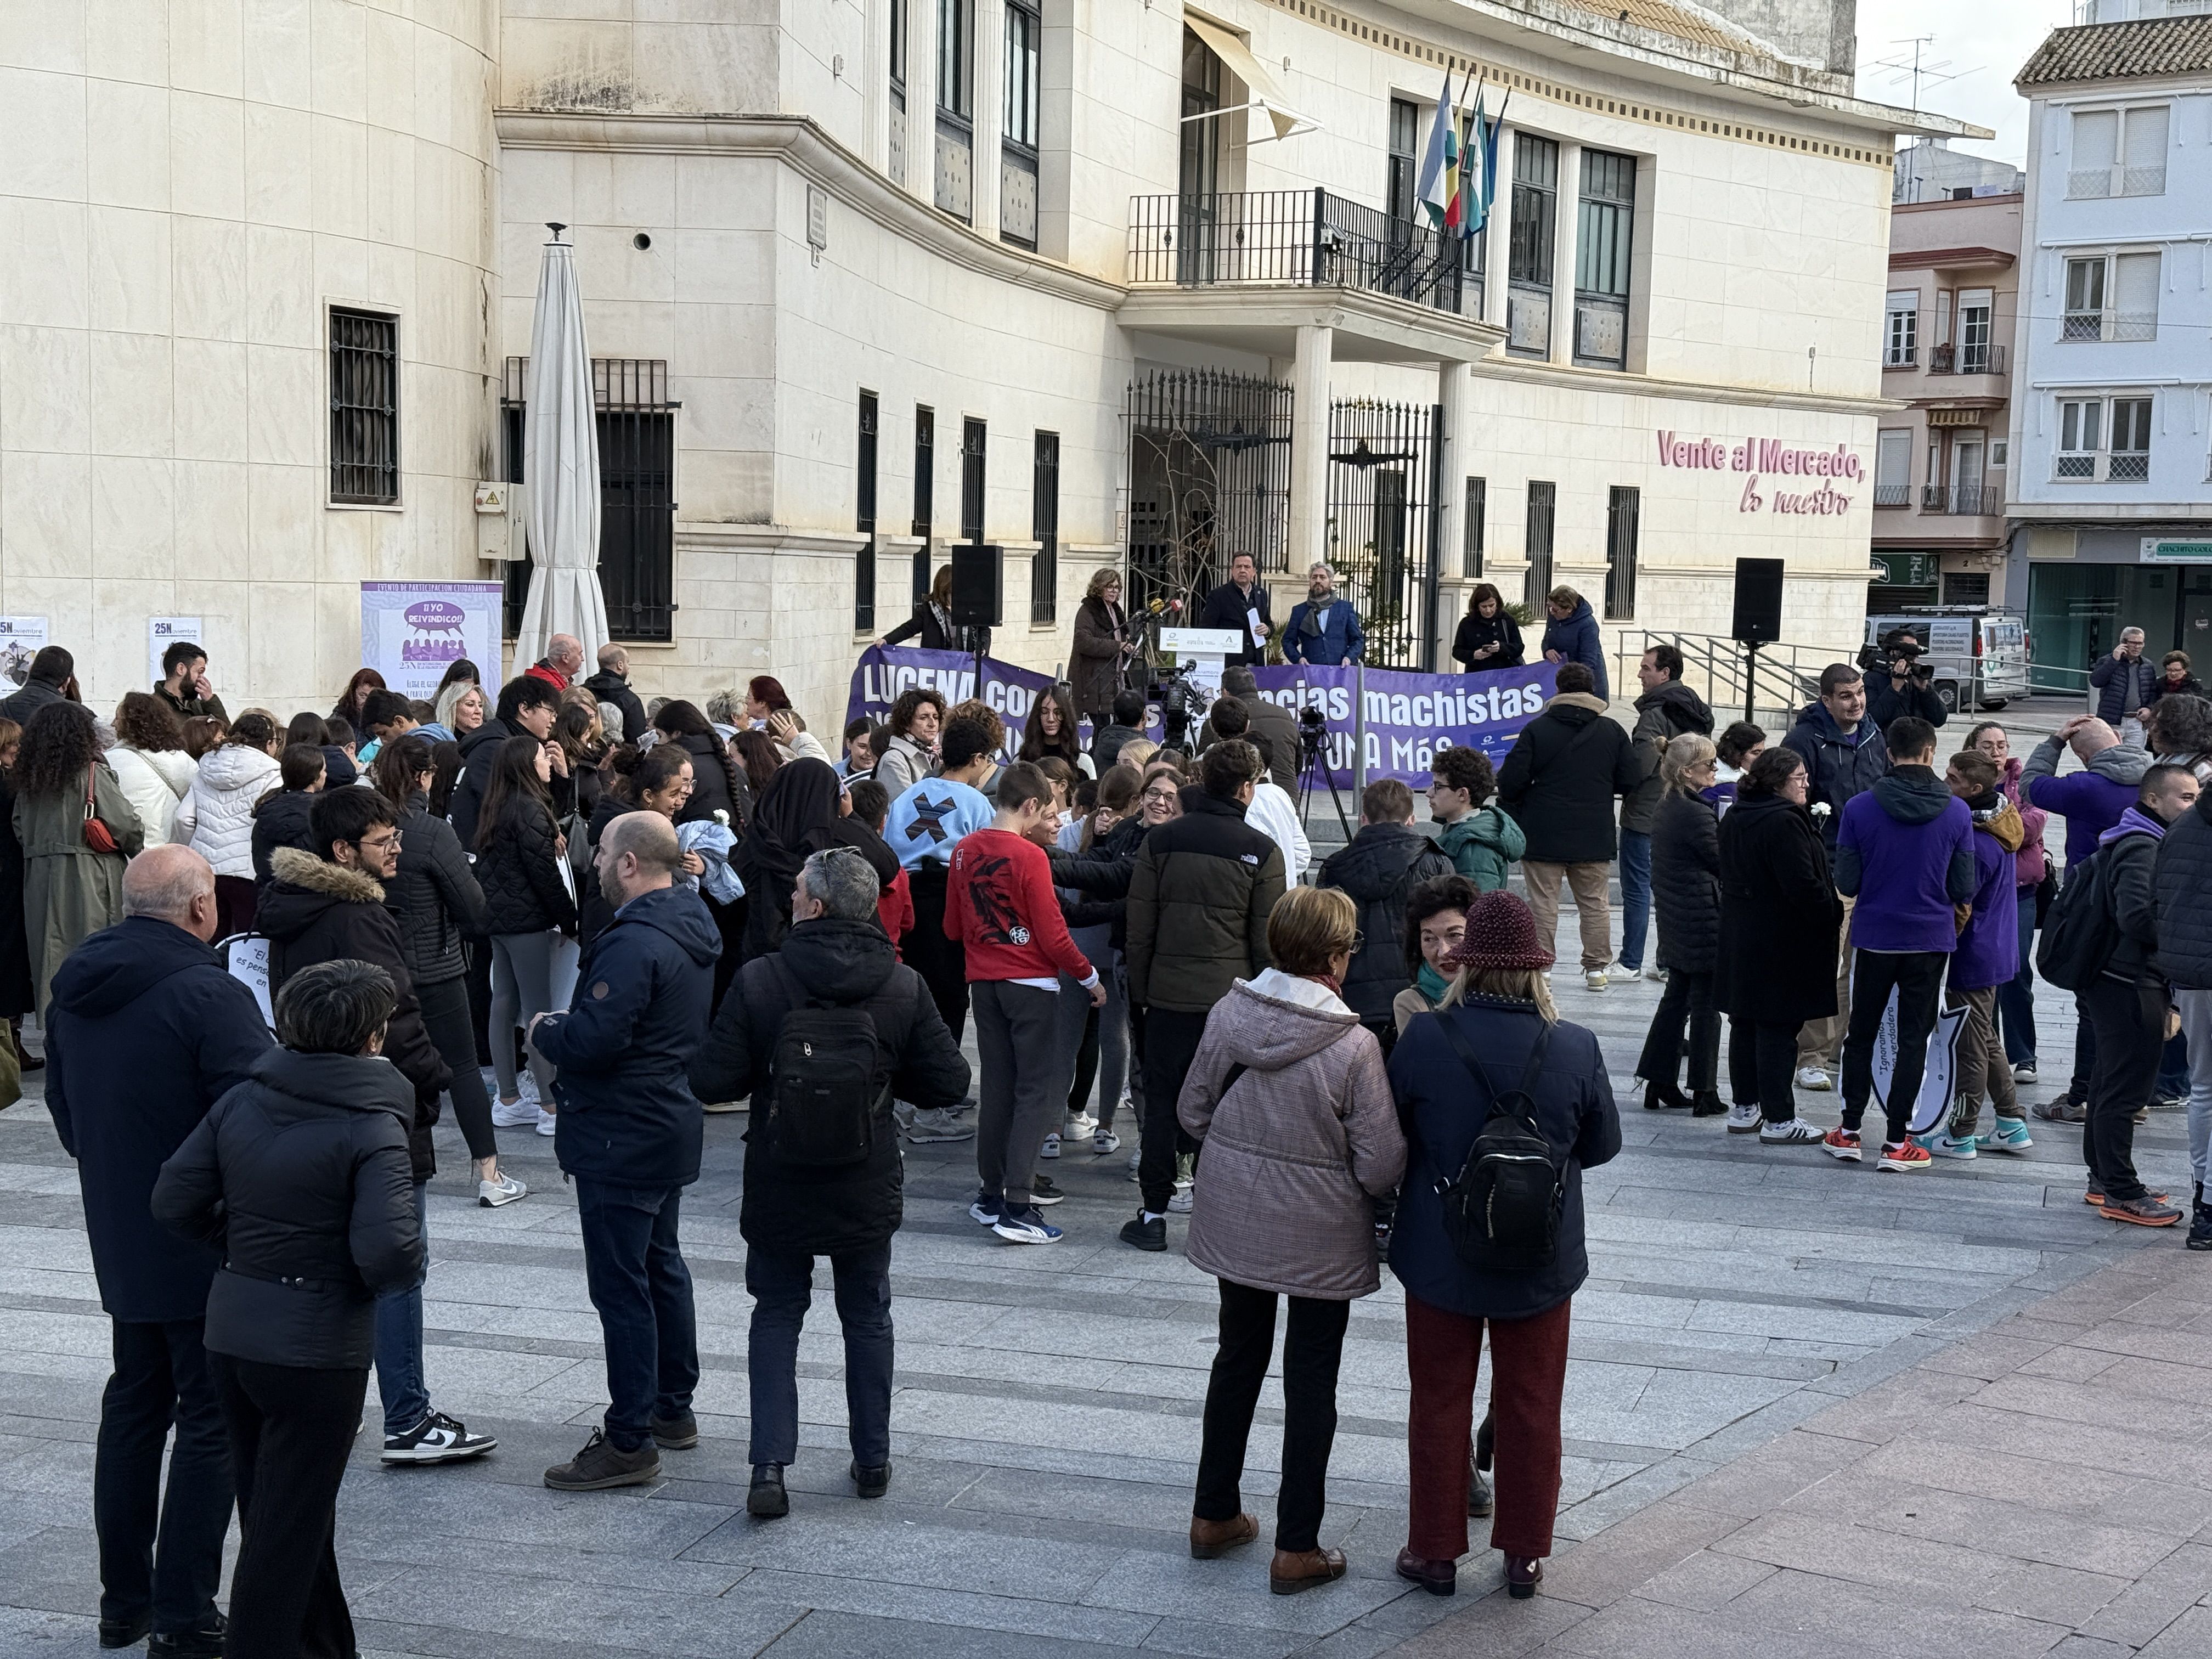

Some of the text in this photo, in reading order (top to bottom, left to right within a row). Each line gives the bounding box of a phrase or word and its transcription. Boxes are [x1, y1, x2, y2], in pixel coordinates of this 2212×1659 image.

[1657, 430, 1866, 484] Vente al Mercado,
[1740, 473, 1855, 516] lo nuestro
[377, 583, 398, 591] EVENTO
[865, 664, 976, 706] LUCENA
[1257, 679, 1350, 720] ncias
[1364, 682, 1544, 727] machistas
[236, 957, 247, 966] es
[256, 979, 267, 988] en
